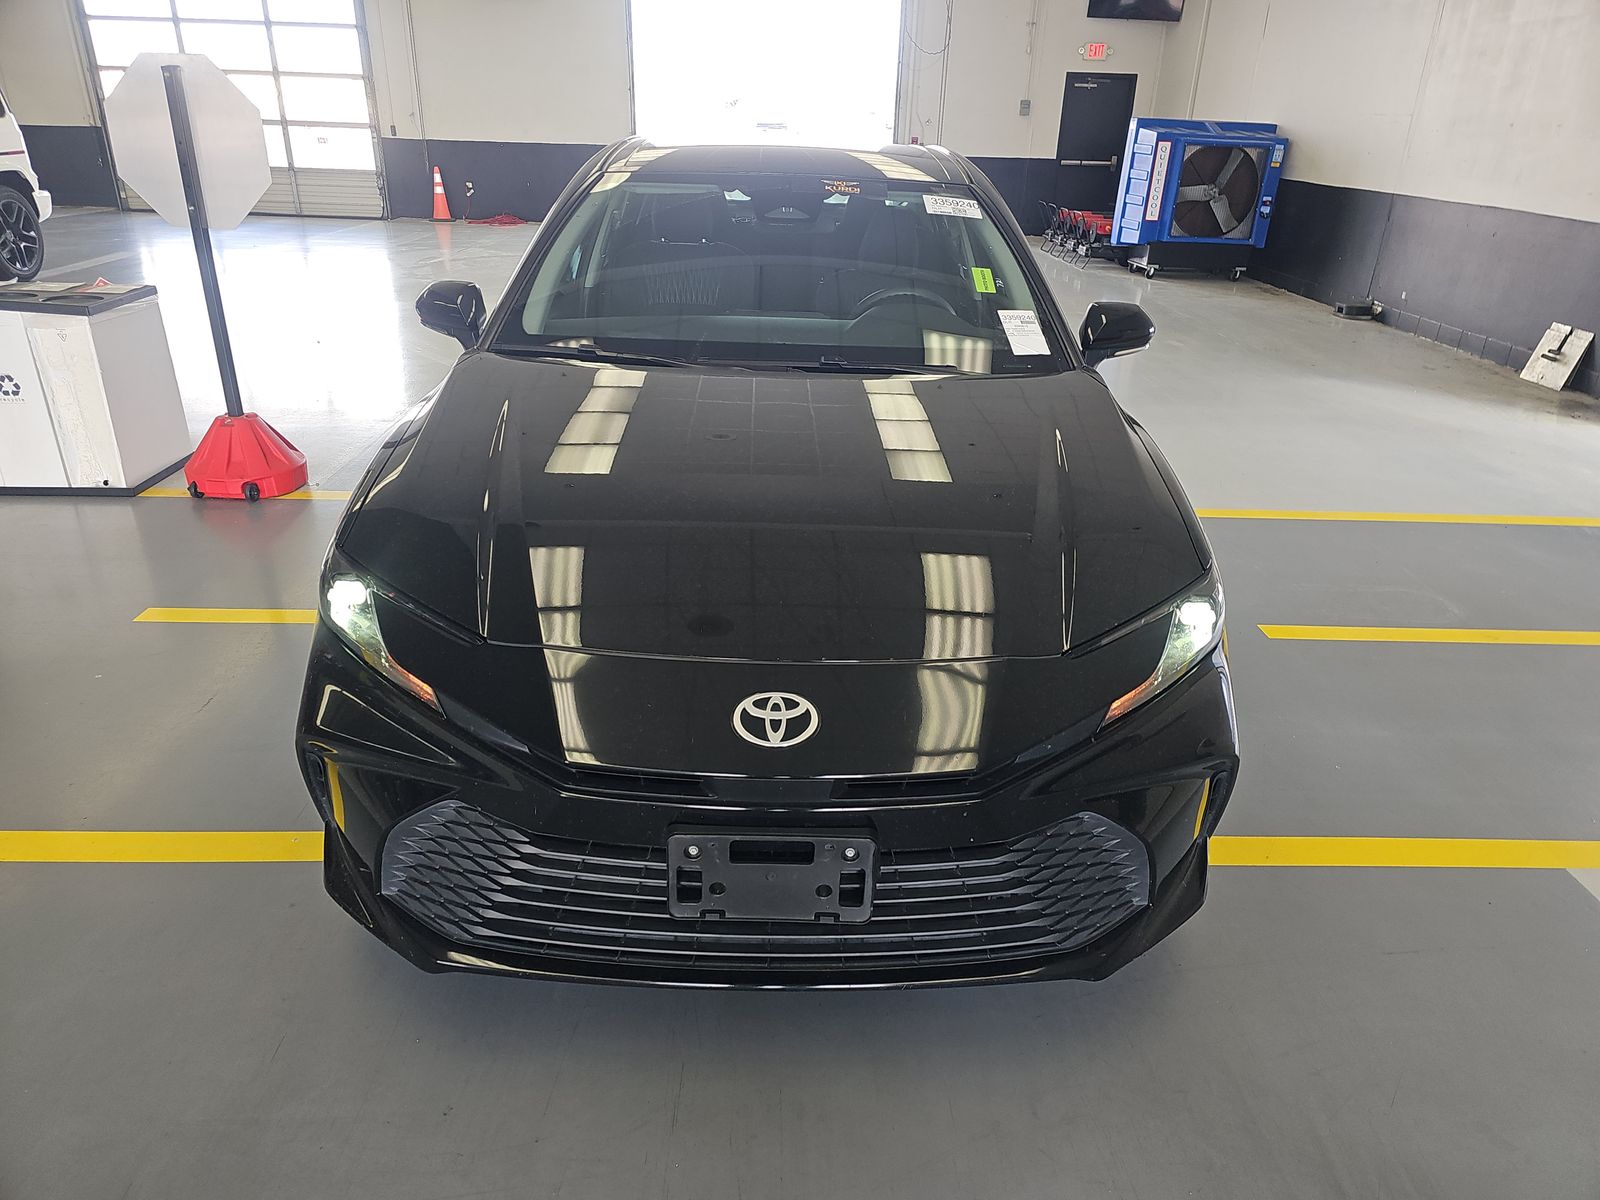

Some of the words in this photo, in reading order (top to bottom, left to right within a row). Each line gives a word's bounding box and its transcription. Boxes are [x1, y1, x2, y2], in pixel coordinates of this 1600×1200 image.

[1088, 43, 1105, 58] EXIT
[1150, 146, 1167, 217] QUIETCOOL
[930, 197, 980, 210] 3359240
